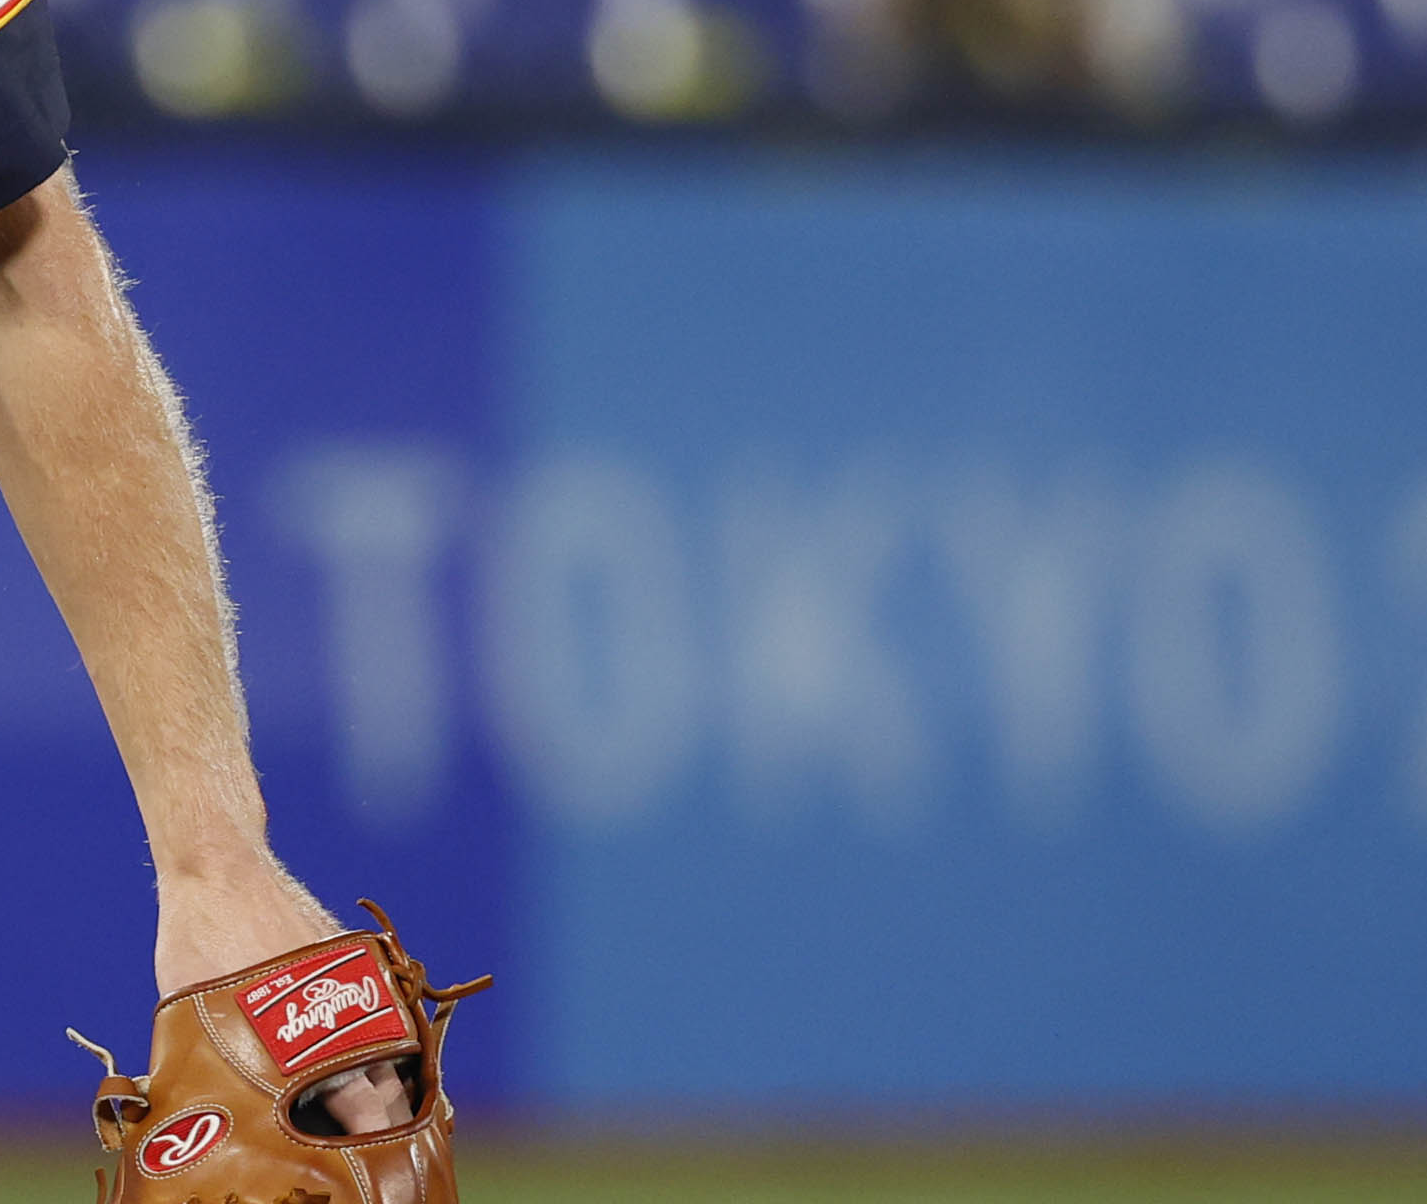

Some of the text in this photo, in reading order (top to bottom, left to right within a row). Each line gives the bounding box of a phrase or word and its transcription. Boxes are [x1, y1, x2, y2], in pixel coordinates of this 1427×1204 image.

[268, 441, 1346, 831] TOKYO
[276, 975, 380, 1043] Rawlings
[151, 1114, 220, 1166] R
